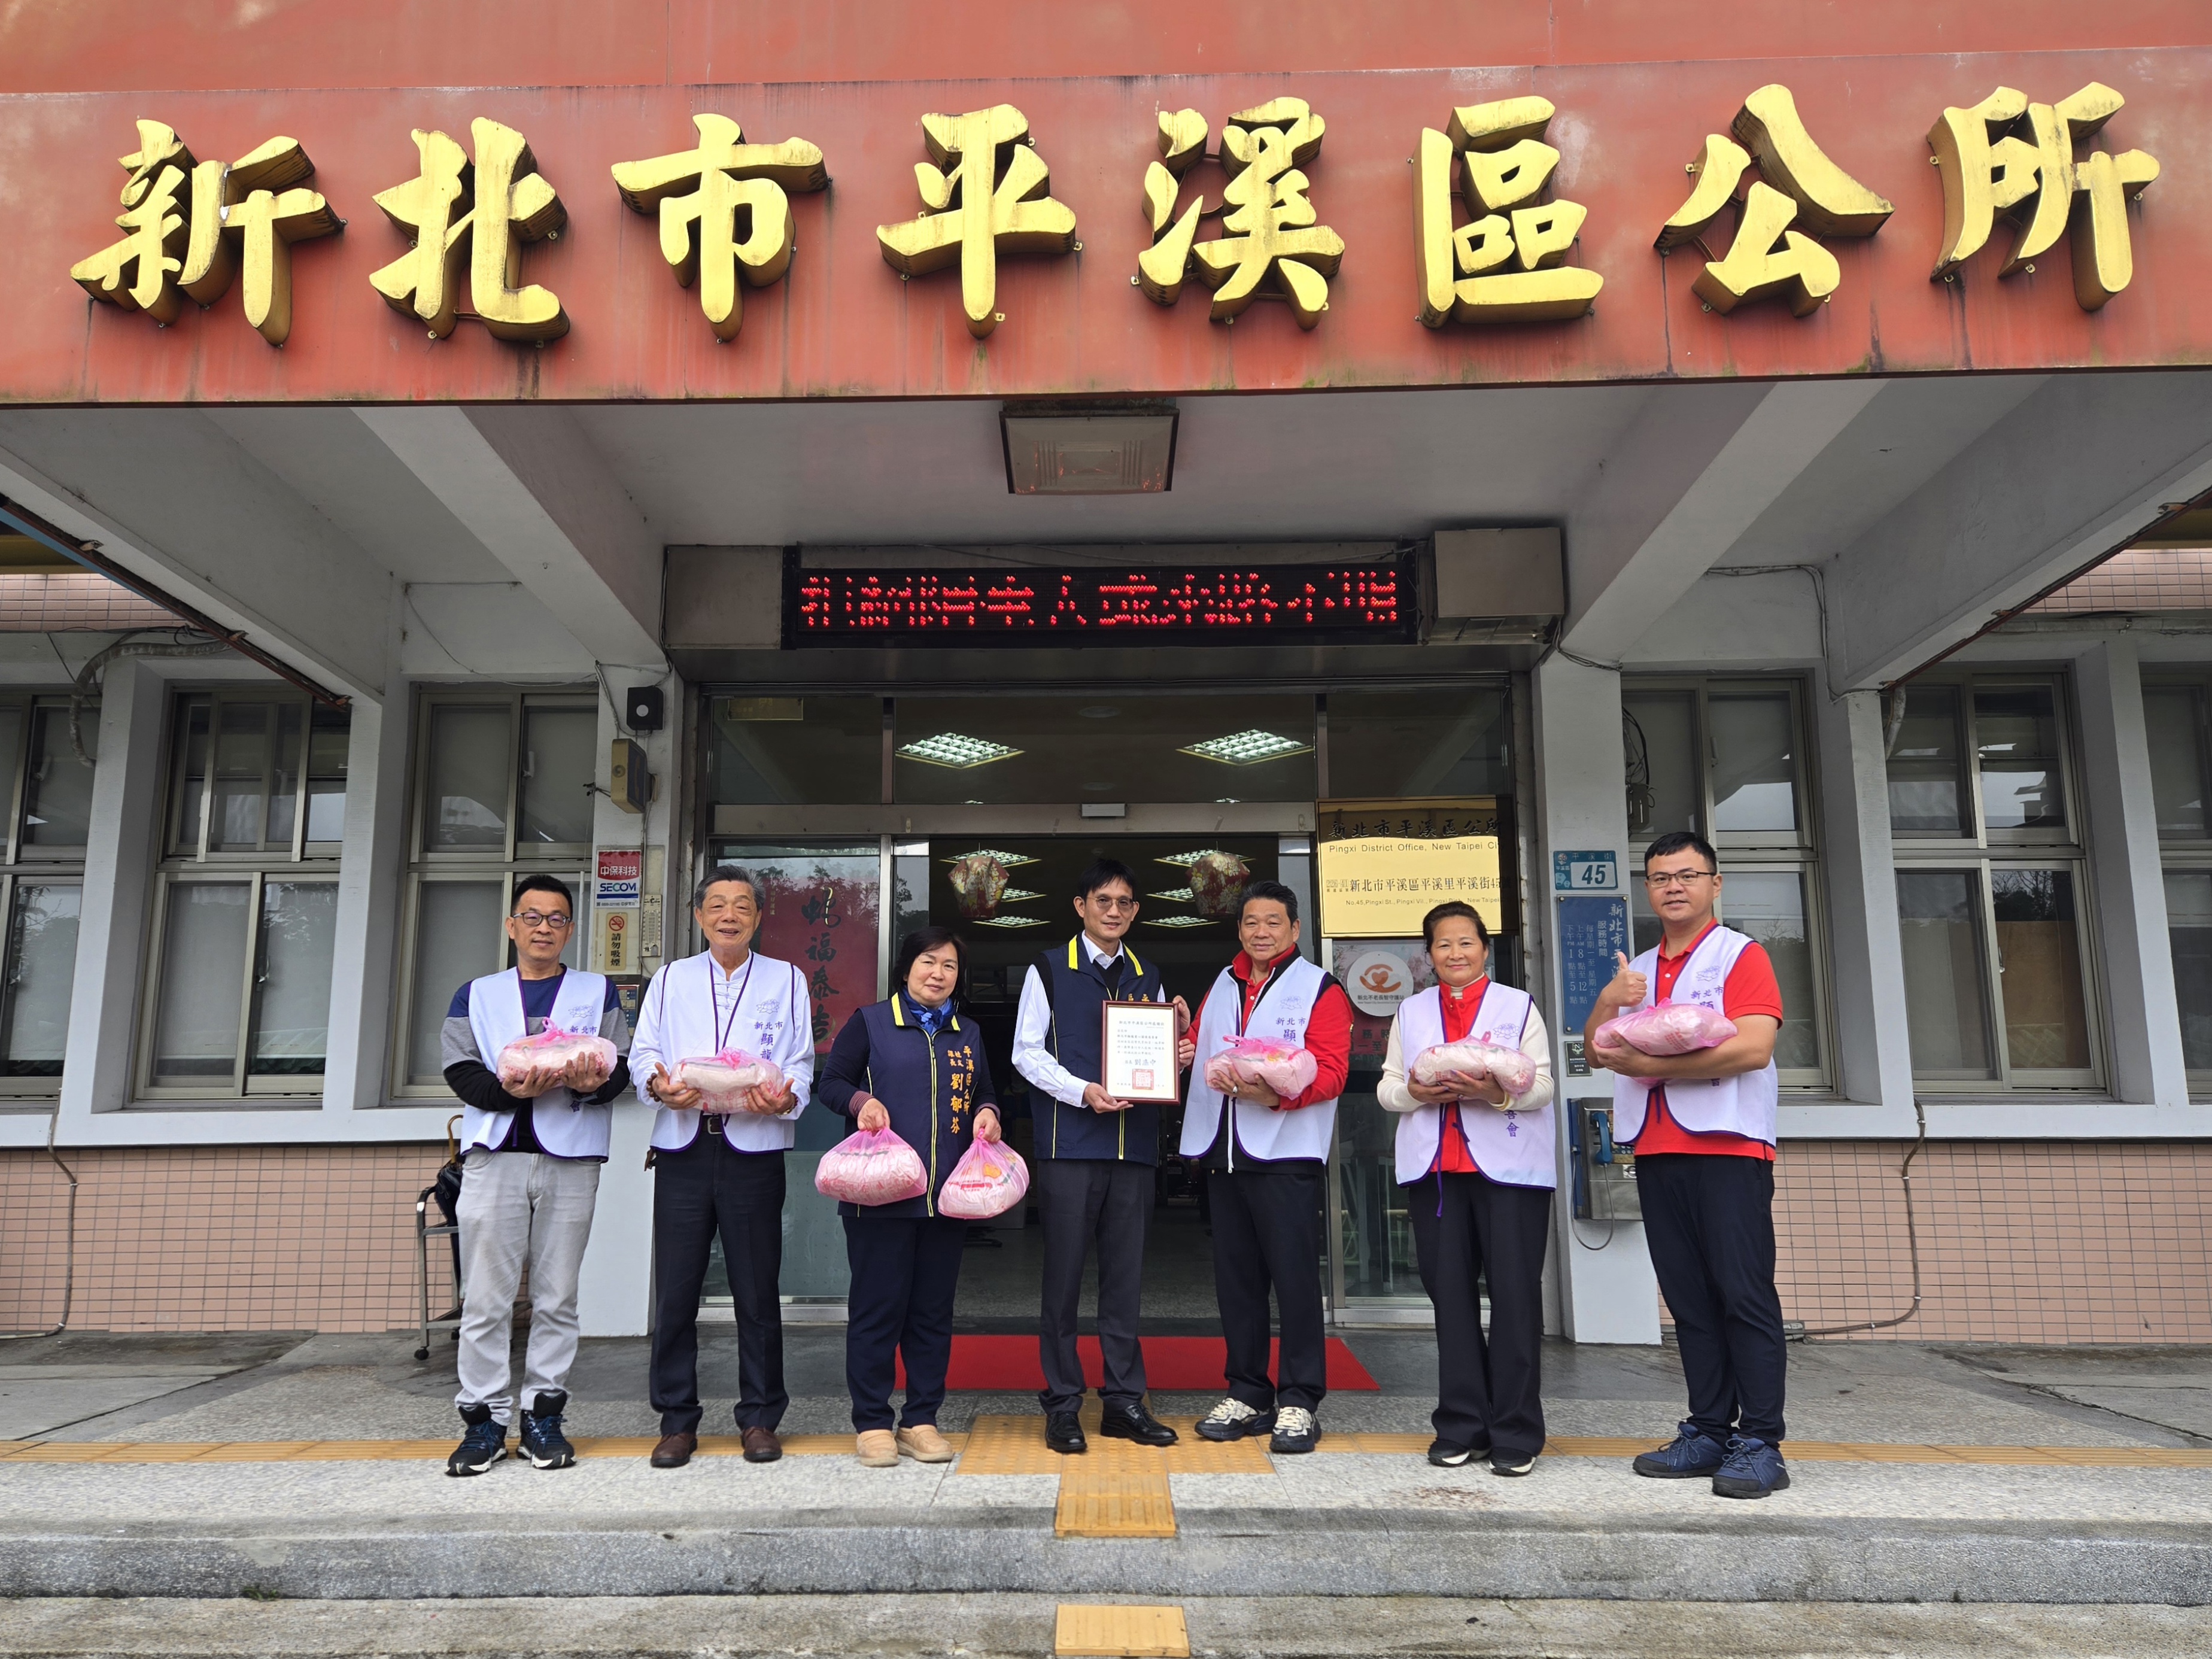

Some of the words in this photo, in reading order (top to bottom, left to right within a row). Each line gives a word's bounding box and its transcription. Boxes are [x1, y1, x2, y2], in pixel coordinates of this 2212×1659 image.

[69, 82, 2162, 345] 新北市平溪區公所
[1328, 817, 1503, 840] 新北市平溪區公所
[1329, 844, 1357, 854] Pingxi
[1362, 844, 1393, 852] District
[1397, 843, 1427, 852] Office,
[1457, 841, 1483, 851] Taipei
[1572, 852, 1612, 861] 平溪街
[600, 865, 637, 876] 中保科技
[1582, 864, 1606, 885] 45
[600, 883, 636, 892] SECOM
[1597, 920, 1608, 957] 服務時間
[610, 933, 621, 967] 請勿吸煙
[1690, 986, 1724, 999] 新北市
[754, 1021, 783, 1030] 新北市
[1275, 1017, 1306, 1026] 新北市
[570, 1025, 597, 1035] 新北市
[1283, 1029, 1296, 1042] 顯
[760, 1033, 774, 1061] 顯龍
[963, 1046, 974, 1115] 平溪區公所
[950, 1073, 964, 1134] 劉郁芬
